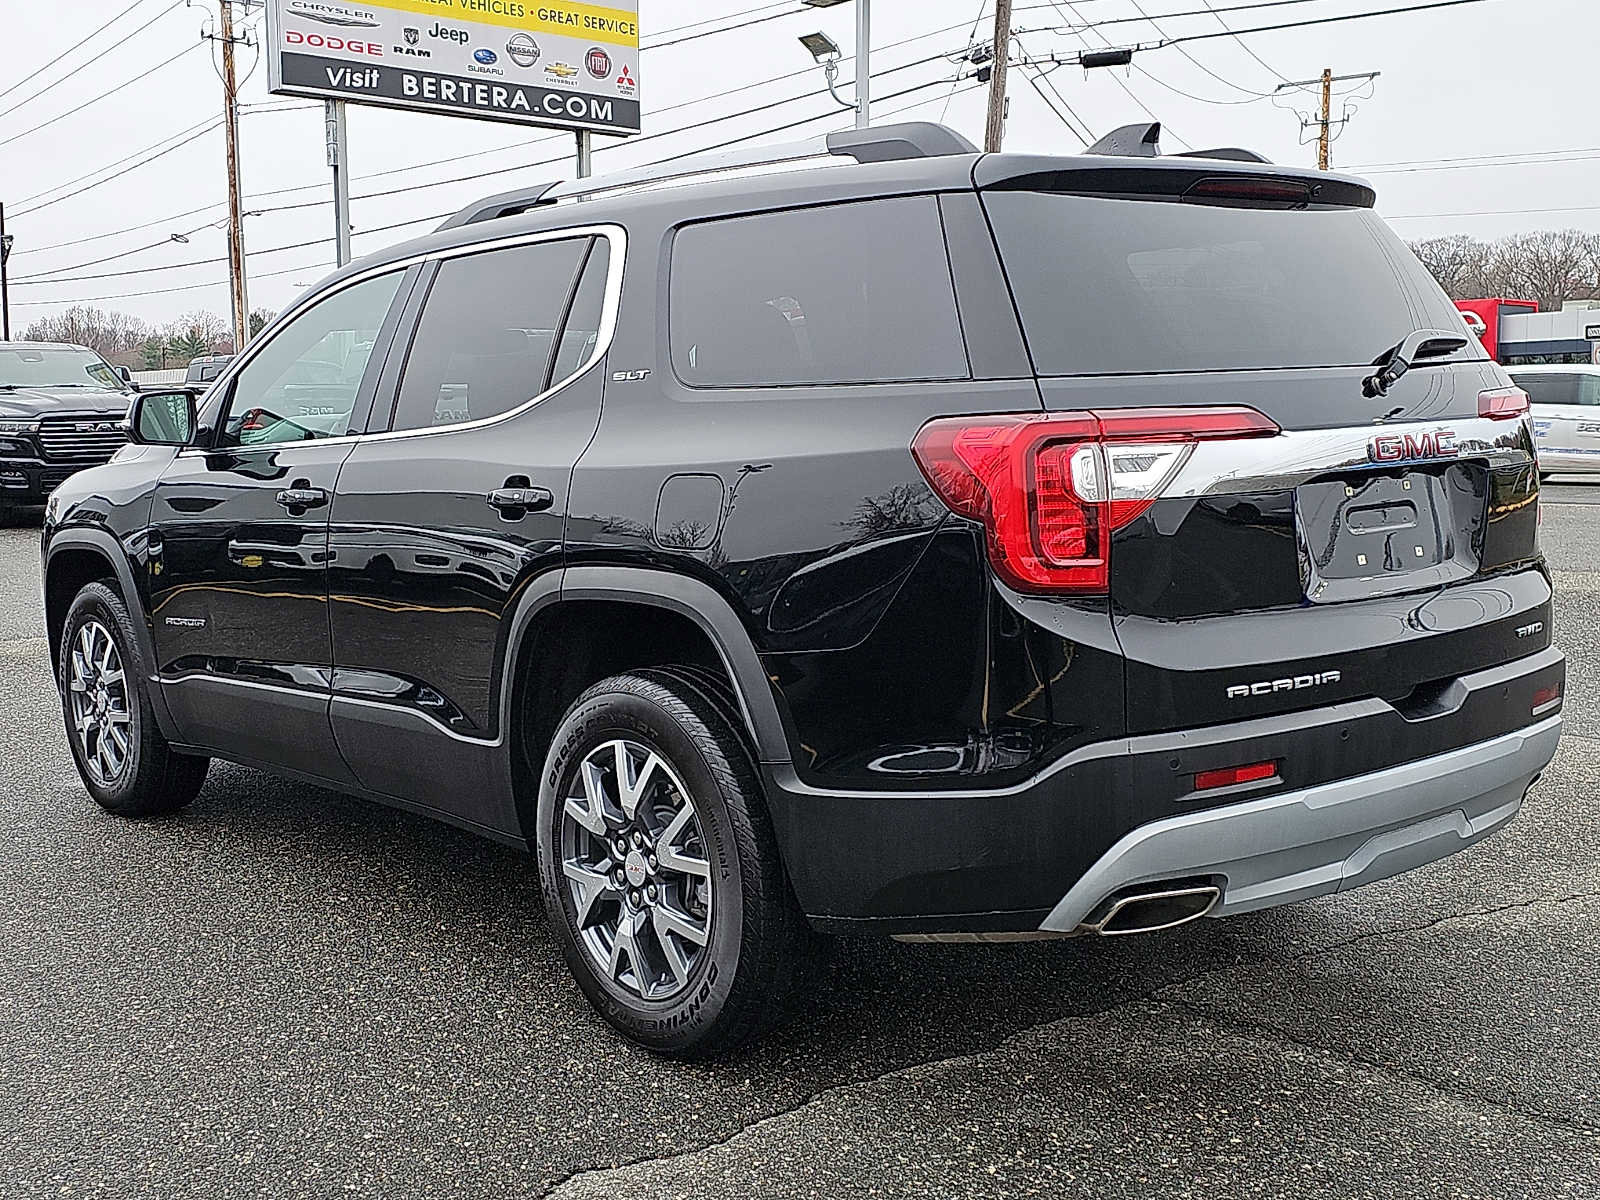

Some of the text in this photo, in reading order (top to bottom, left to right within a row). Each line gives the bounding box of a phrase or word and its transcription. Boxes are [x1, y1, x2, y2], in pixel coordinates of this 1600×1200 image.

[291, 1, 375, 20] CHRYSLER
[461, 0, 636, 35] VEHICLES GREAT SERVICE
[428, 22, 469, 45] Jeep
[286, 31, 384, 56] DODGE
[393, 46, 431, 58] RAM
[510, 45, 538, 56] NISSAN
[467, 64, 504, 76] SUBARU
[545, 77, 578, 86] CHEVROLET
[325, 67, 613, 121] Visit BERTERA.COM
[612, 368, 652, 381] SLT
[1374, 431, 1457, 460] GMC
[165, 616, 206, 627] ACADIA
[1226, 670, 1341, 699] ACADIA
